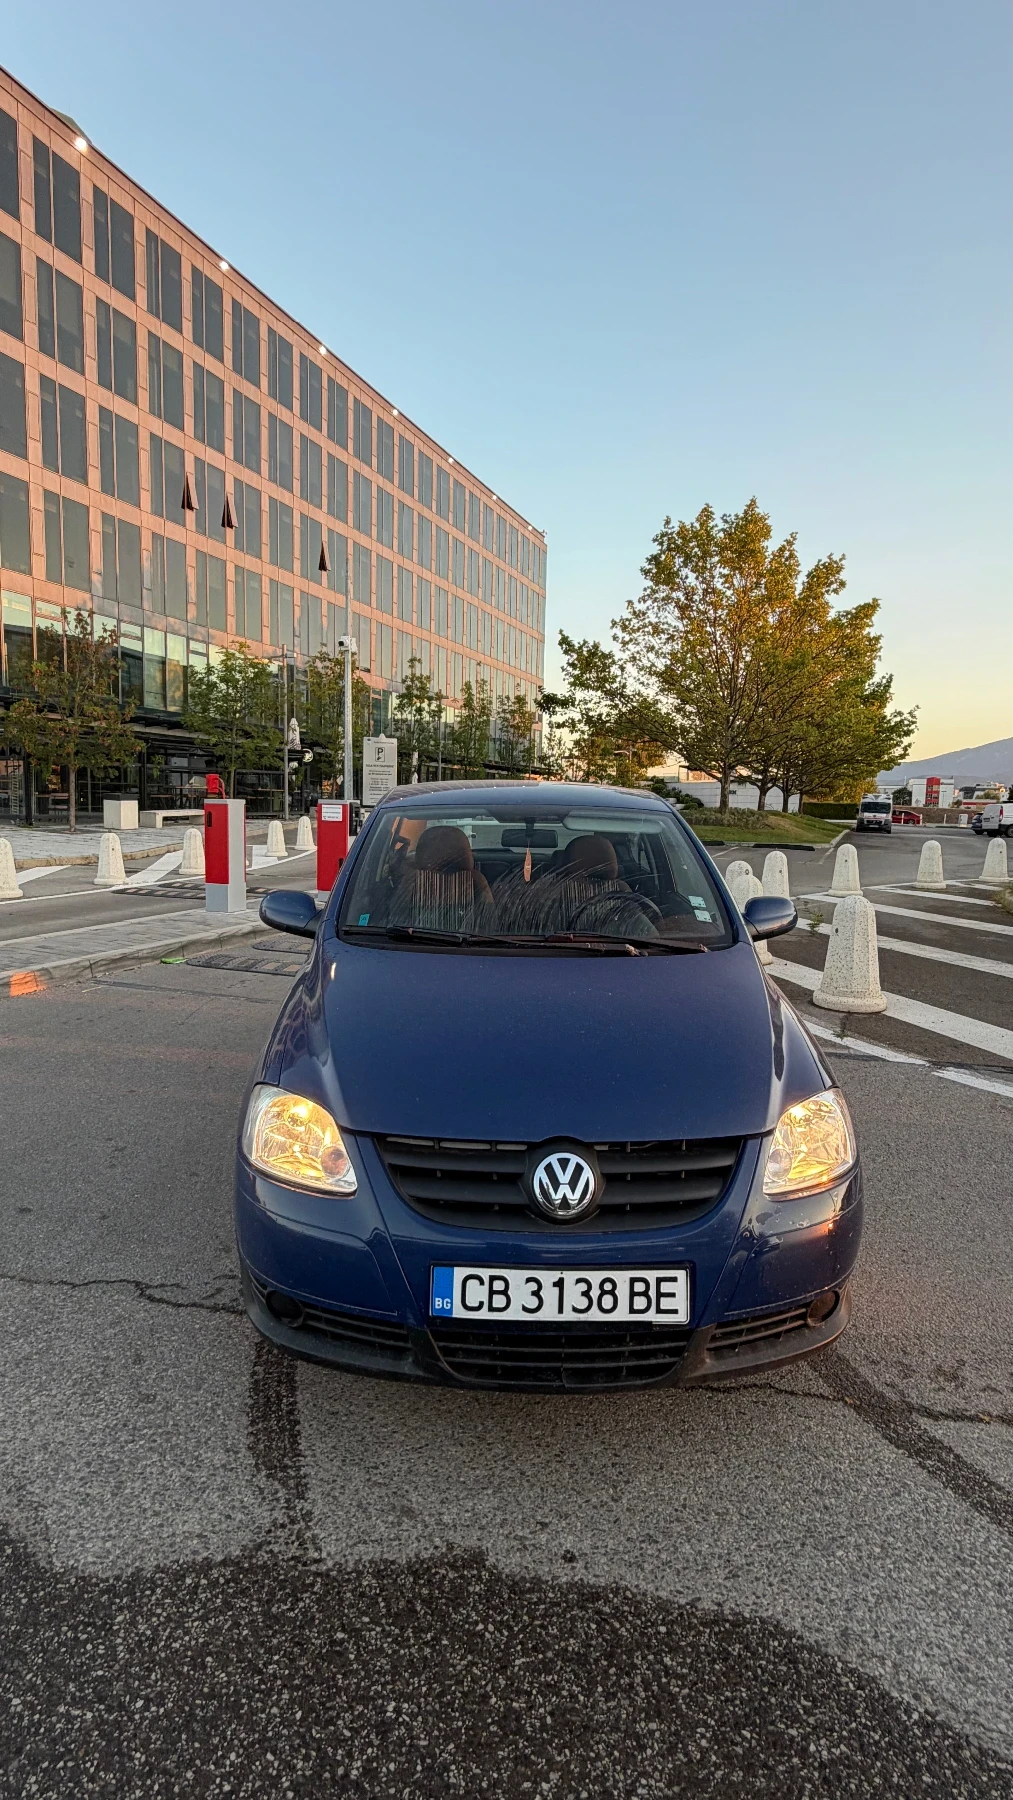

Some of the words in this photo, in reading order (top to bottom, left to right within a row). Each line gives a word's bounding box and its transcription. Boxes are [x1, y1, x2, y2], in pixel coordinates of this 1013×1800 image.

[377, 748, 384, 756] P
[533, 1152, 595, 1217] VW
[434, 1298, 451, 1310] BG
[460, 1274, 512, 1313] CB
[521, 1276, 619, 1315] 3138
[629, 1276, 679, 1315] BE
